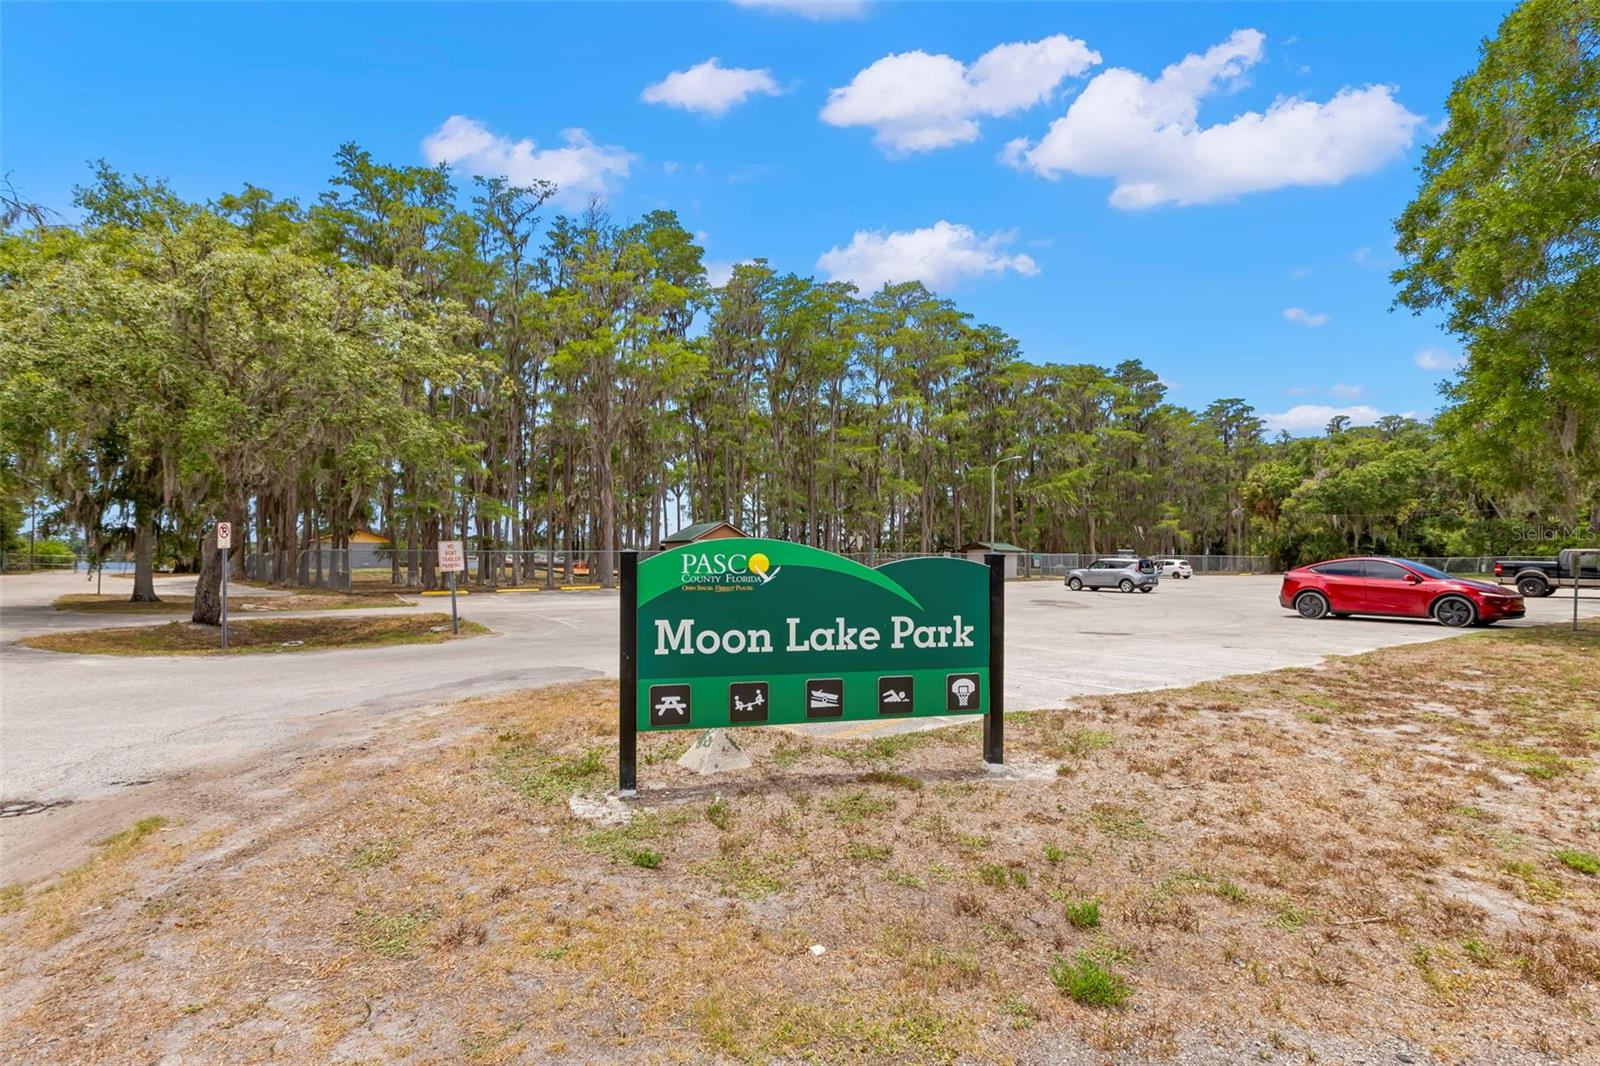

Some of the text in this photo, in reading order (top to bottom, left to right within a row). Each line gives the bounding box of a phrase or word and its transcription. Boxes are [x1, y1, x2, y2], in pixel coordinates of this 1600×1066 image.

[681, 573, 762, 583] COUNTY FLORIDA
[654, 615, 974, 655] Moon Lake Park
